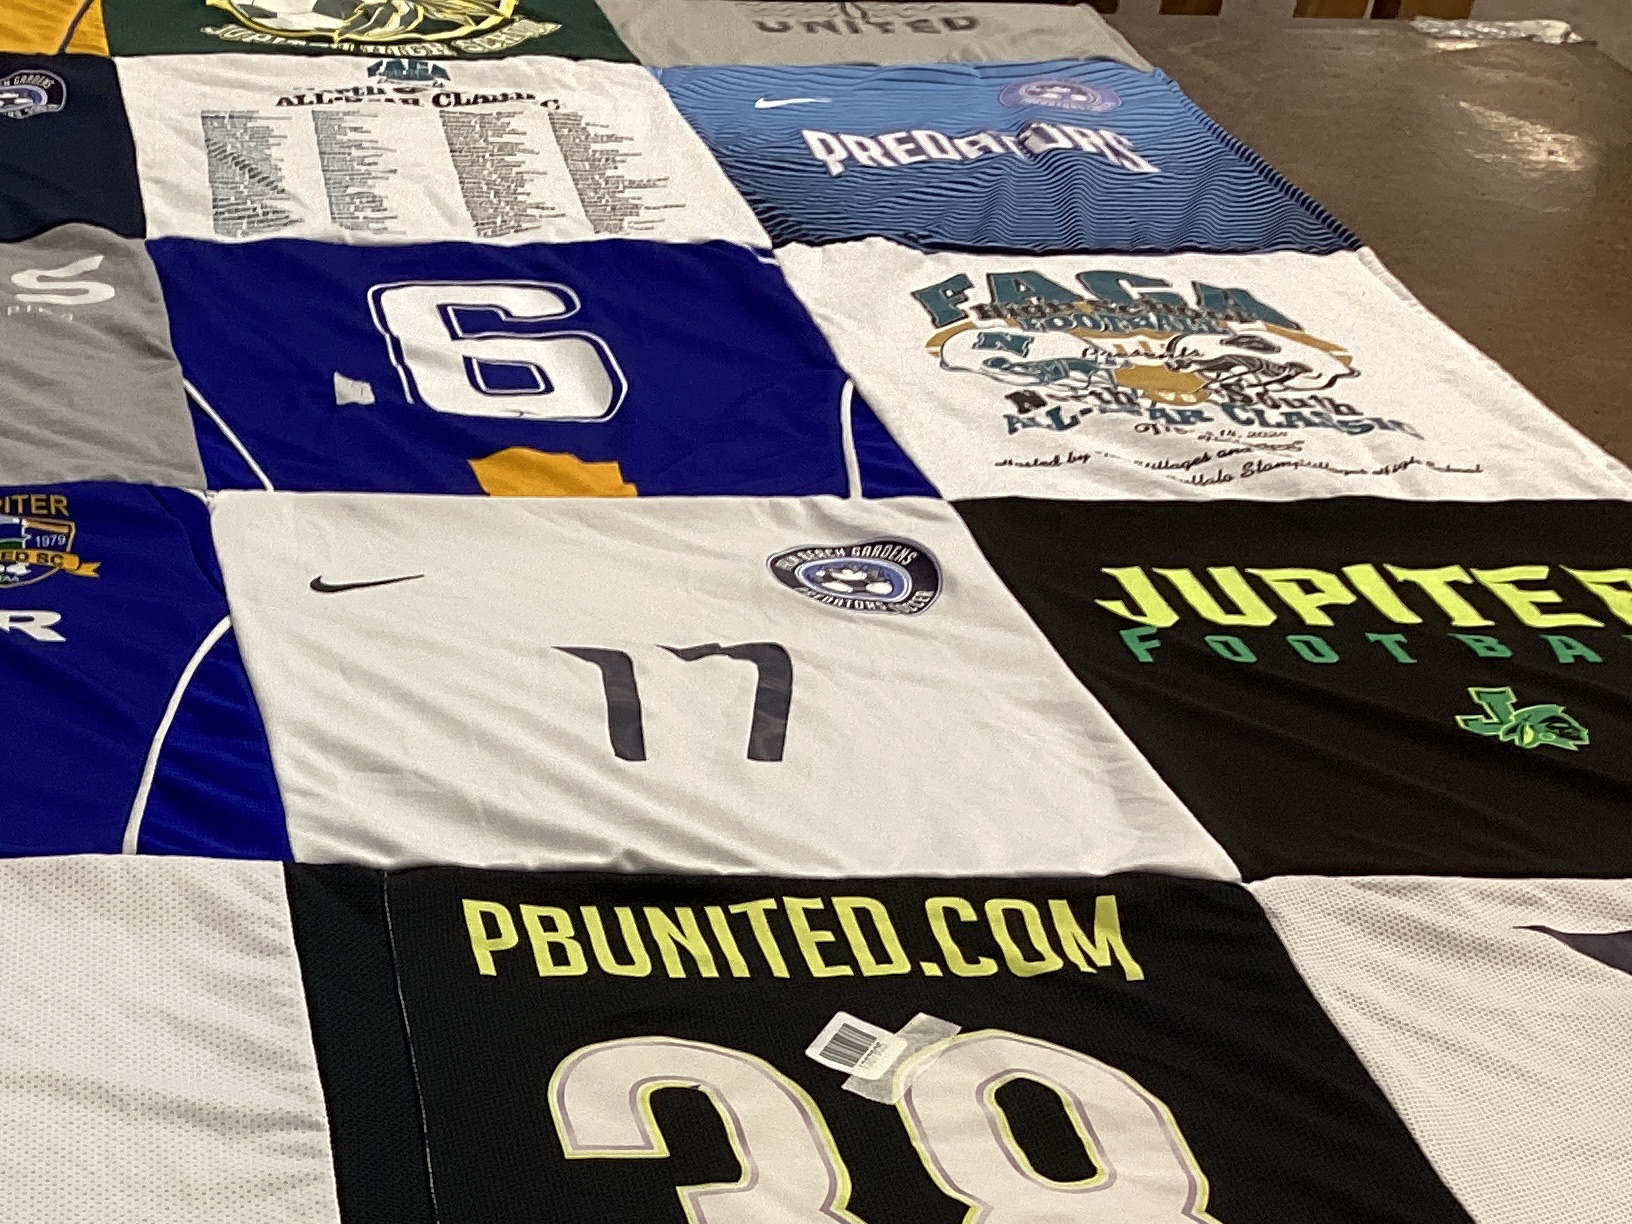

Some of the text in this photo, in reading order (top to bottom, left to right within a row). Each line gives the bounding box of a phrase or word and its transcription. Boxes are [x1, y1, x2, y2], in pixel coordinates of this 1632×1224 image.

[753, 15, 980, 35] UNITED
[368, 279, 629, 423] 6
[34, 534, 67, 549] 1979
[1119, 626, 1632, 664] FOOTBA
[551, 642, 794, 762] 17
[462, 894, 1145, 982] PBUNITED.COM
